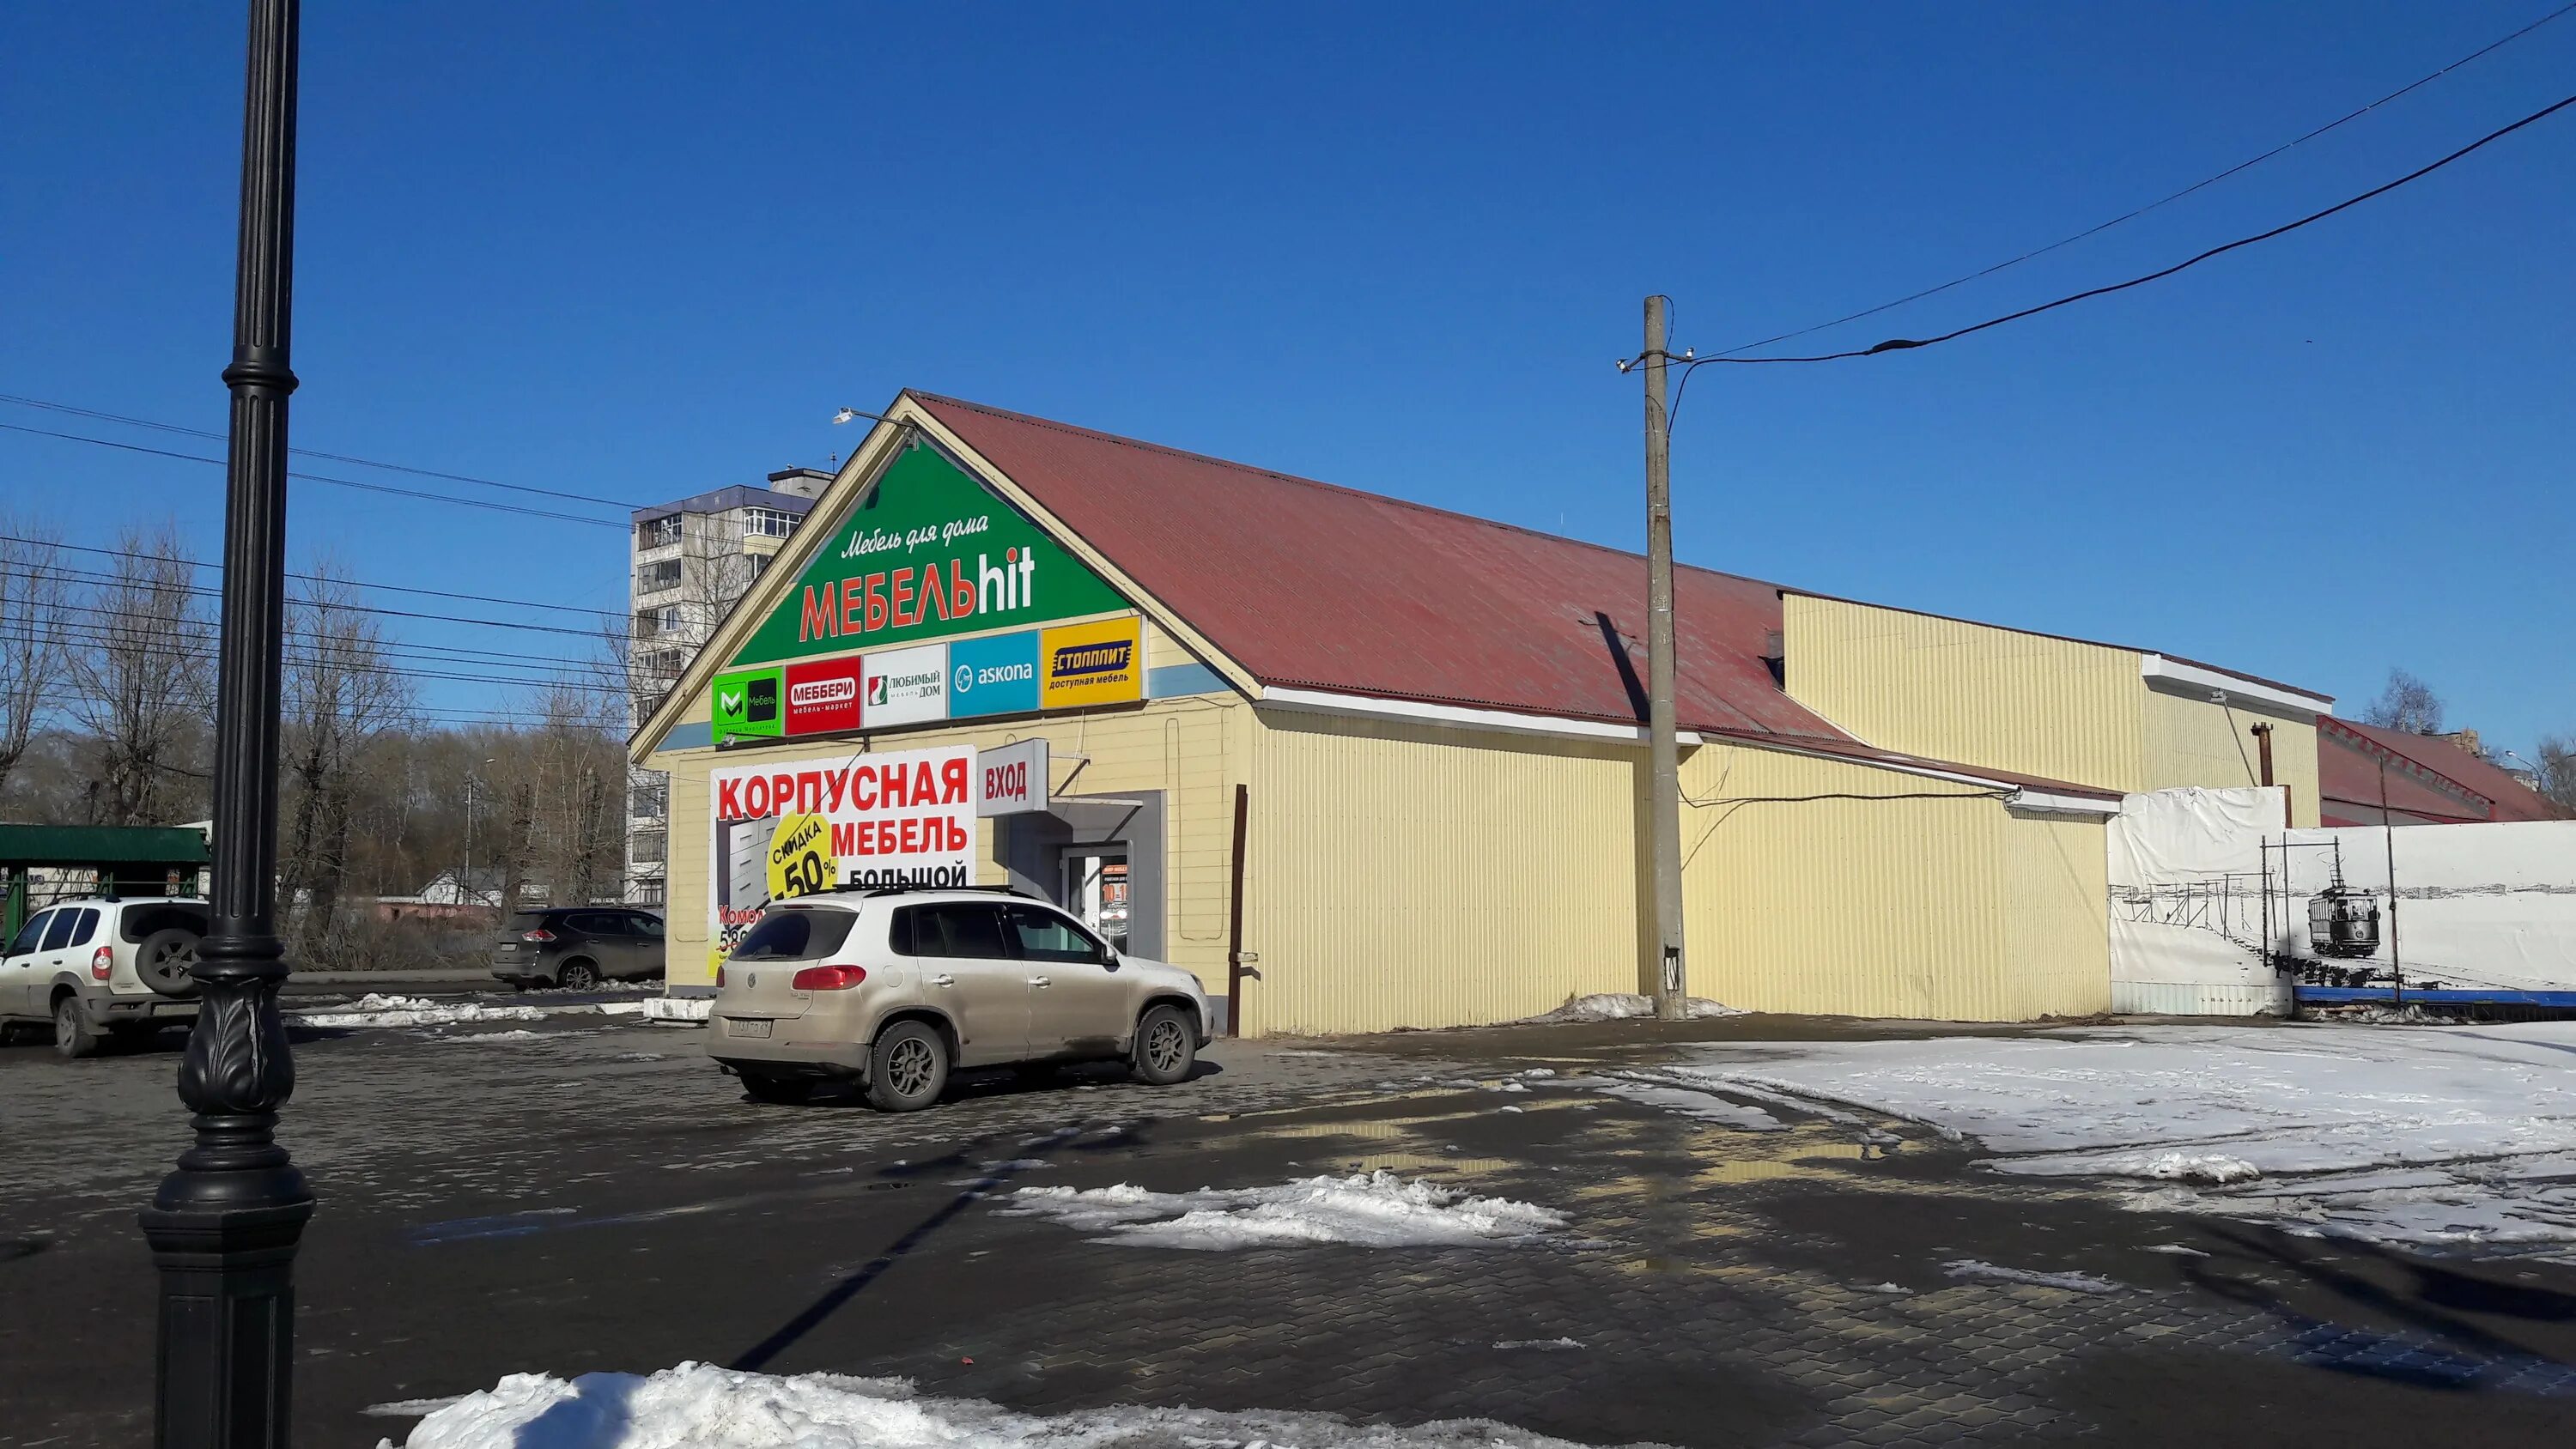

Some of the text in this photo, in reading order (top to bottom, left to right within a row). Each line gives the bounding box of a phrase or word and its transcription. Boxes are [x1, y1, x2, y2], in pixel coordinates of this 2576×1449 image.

[841, 515, 989, 559] Мебель для дома
[889, 670, 940, 688] ЛЮБИМЫЙ
[978, 663, 1033, 685] askona
[1048, 673, 1129, 691] доступная мебель
[749, 694, 775, 707] Мебель
[793, 681, 853, 702] МЕББЕРИ
[919, 684, 940, 698] ДОМ
[793, 702, 853, 715] мебель-маркет
[719, 757, 968, 821] КОРПУСНАЯ
[985, 761, 1027, 802] ВХОД
[773, 821, 822, 864] СКИДКА
[830, 815, 968, 858] МЕБЕЛЬ
[850, 859, 967, 888] БОЛЬШОЙ
